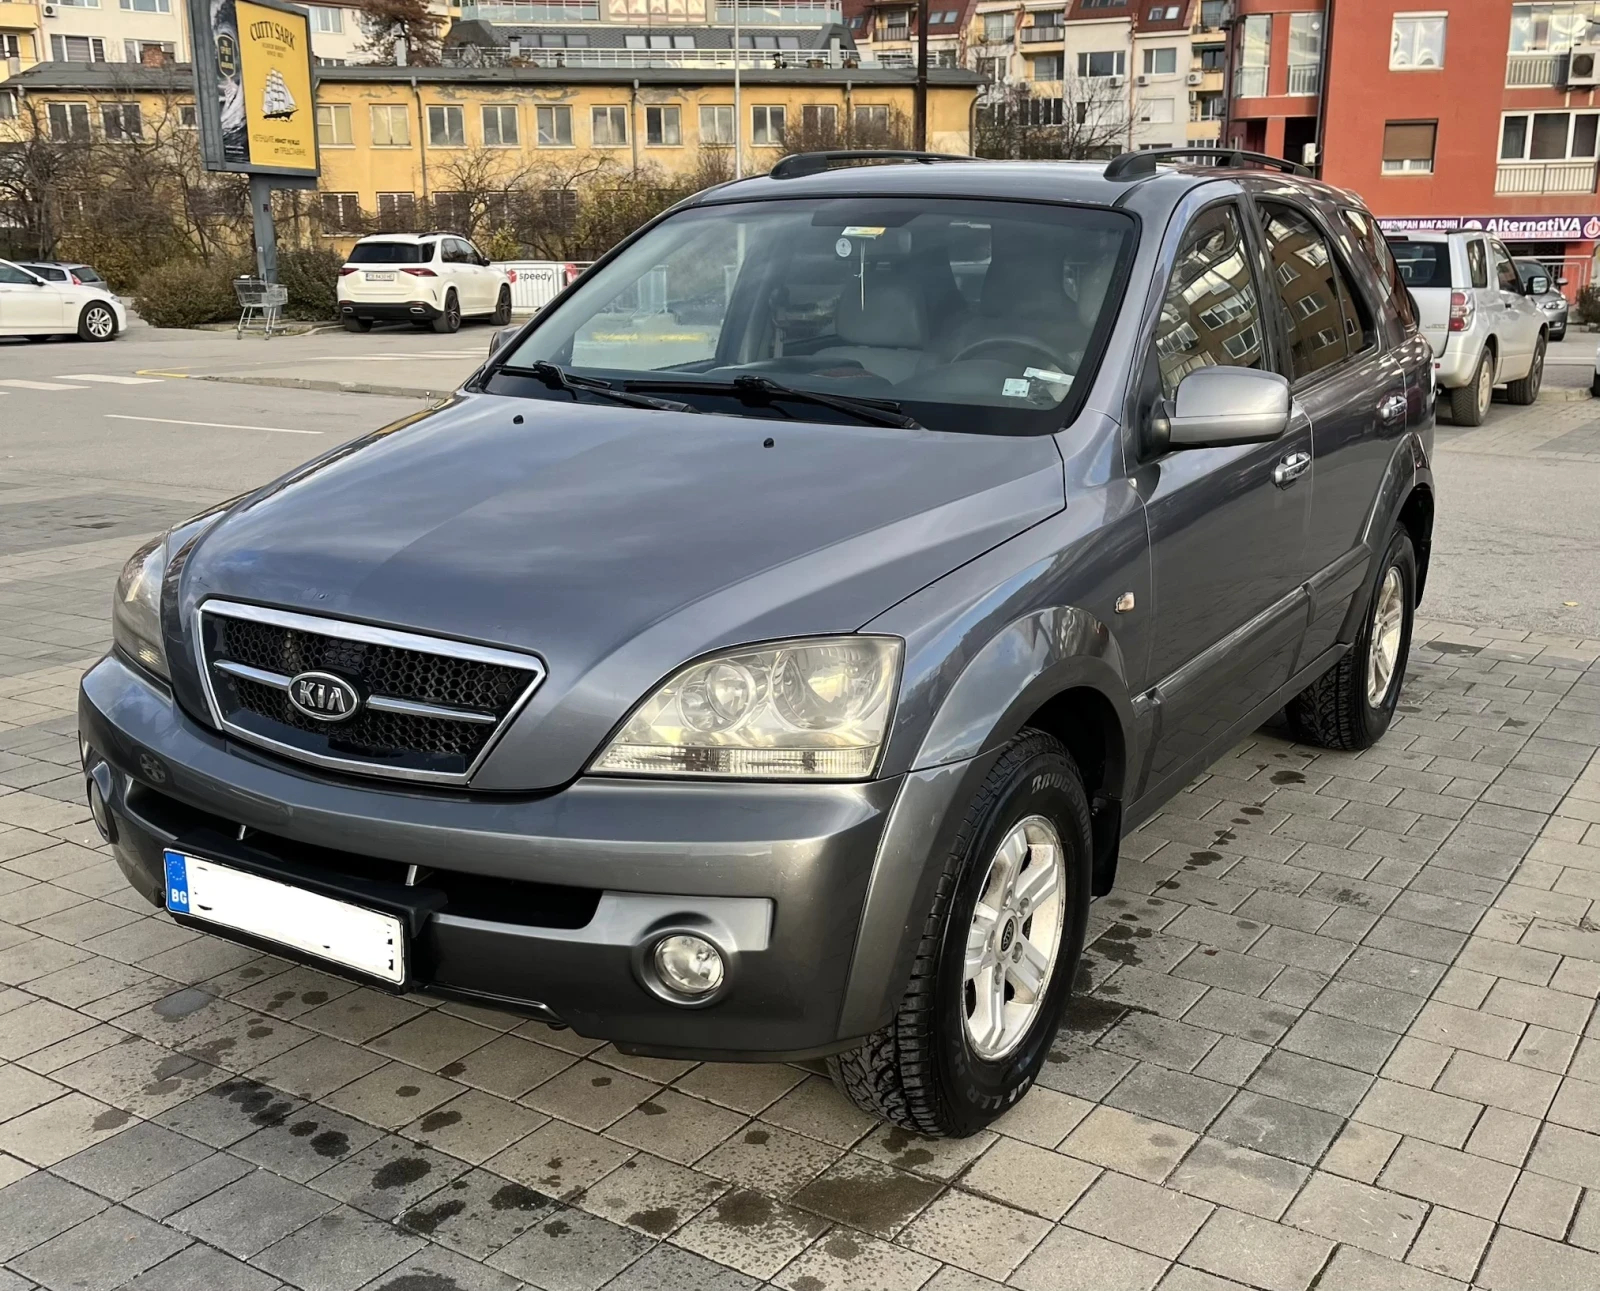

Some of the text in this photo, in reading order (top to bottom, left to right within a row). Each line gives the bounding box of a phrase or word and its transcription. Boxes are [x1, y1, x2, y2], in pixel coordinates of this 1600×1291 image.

[250, 21, 274, 41] CUTTY
[275, 22, 296, 51] SARK
[1419, 219, 1458, 230] МАГАЗИН
[1486, 217, 1581, 232] AlternatiVA
[519, 272, 552, 282] speedy
[300, 680, 346, 712] KIA
[171, 888, 187, 904] BG
